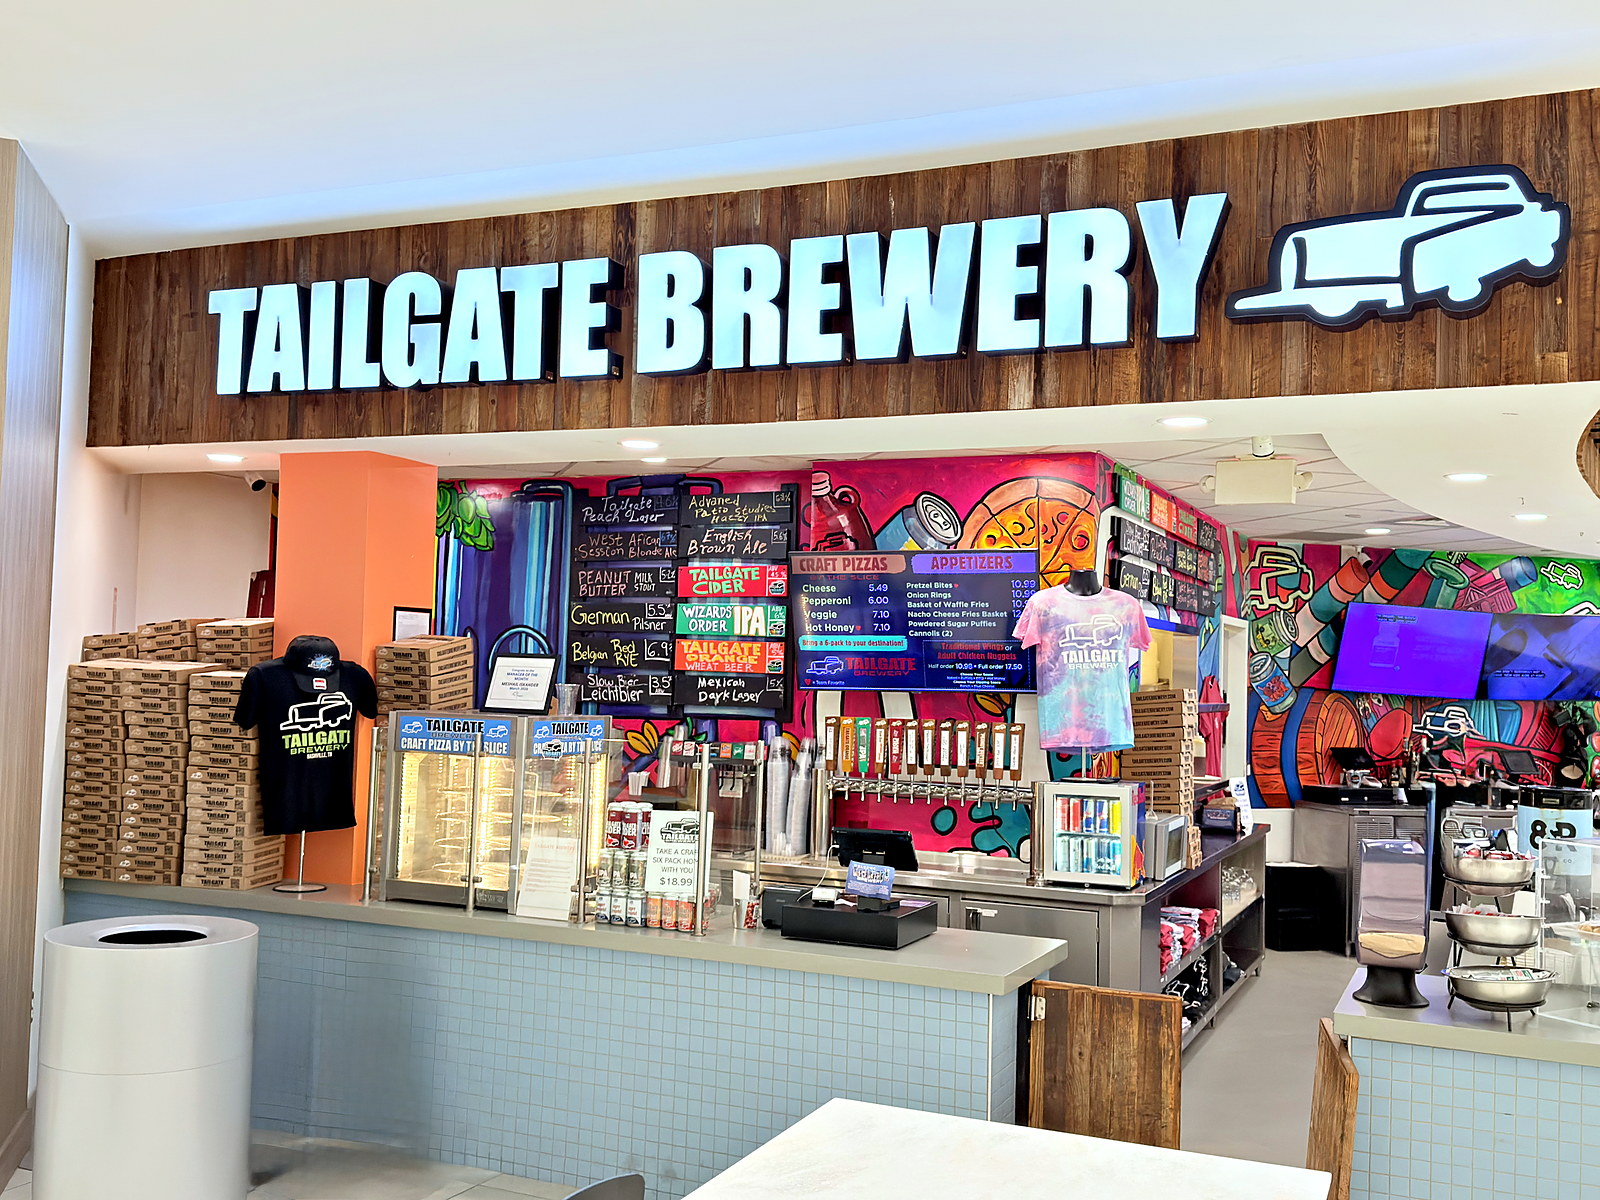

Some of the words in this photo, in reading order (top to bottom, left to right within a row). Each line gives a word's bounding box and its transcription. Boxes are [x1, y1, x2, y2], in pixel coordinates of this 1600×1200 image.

[208, 257, 614, 396] TAILGATE
[635, 192, 1227, 374] BREWERY
[602, 496, 651, 516] Tailgate
[695, 507, 729, 518] Patio
[582, 506, 619, 523] Peach
[629, 511, 664, 523] Lager
[754, 513, 768, 522] IPA
[702, 528, 753, 545] English
[578, 544, 624, 558] Session
[629, 547, 662, 558] Blonde
[664, 547, 677, 558] Ale
[687, 539, 735, 556] Brown
[742, 540, 768, 554] Ale
[800, 558, 837, 572] CRAFT
[842, 557, 888, 572] PIZZAS
[931, 556, 1013, 570] APPETIZERS
[578, 570, 631, 584] PEANUT
[634, 572, 653, 583] MILK
[688, 566, 761, 581] TAILGATE
[580, 584, 626, 597] BUTTER
[634, 583, 655, 592] STOUT
[692, 579, 745, 595] CIDER
[802, 584, 837, 592] Cheese
[868, 583, 889, 592] 5.49
[1011, 580, 1036, 588] 10.99
[802, 596, 851, 606] Pepperoni
[867, 596, 889, 605] 6.00
[906, 591, 929, 599] Onion
[931, 591, 952, 600] Rings
[571, 605, 630, 625] German
[733, 605, 766, 637] IPA
[804, 610, 838, 620] Veggie
[872, 610, 890, 618] 7.10
[632, 616, 667, 631] Pilsner
[688, 618, 728, 633] ORDER
[805, 623, 822, 632] Hot
[824, 623, 855, 633] Honey
[873, 623, 891, 631] 7.10
[908, 620, 946, 628] Powdered
[947, 621, 969, 629] Sugar
[941, 630, 953, 638] (2)
[610, 639, 636, 654] Red
[681, 641, 762, 656] TAILGATE
[613, 652, 639, 668] RYE
[685, 653, 759, 664] ORANGE
[987, 652, 1017, 660] Nuggets
[1061, 649, 1123, 664] TAILGATE
[685, 662, 719, 671] WHEAT
[724, 663, 754, 672] BEER
[845, 657, 917, 670] TAILGATE
[587, 674, 614, 686] Slow
[697, 677, 745, 689] Mexican
[581, 685, 644, 702] Leichtbier
[698, 689, 730, 706] Dark
[732, 689, 765, 703] Lager
[425, 718, 484, 733] TAILGATE
[551, 721, 589, 735] TAILGATE
[290, 743, 348, 755] BREWERY
[401, 737, 427, 750] CRAFT
[428, 739, 452, 751] PIZZA
[453, 740, 465, 752] BY
[569, 741, 576, 753] BY
[660, 877, 692, 886] $18.99
